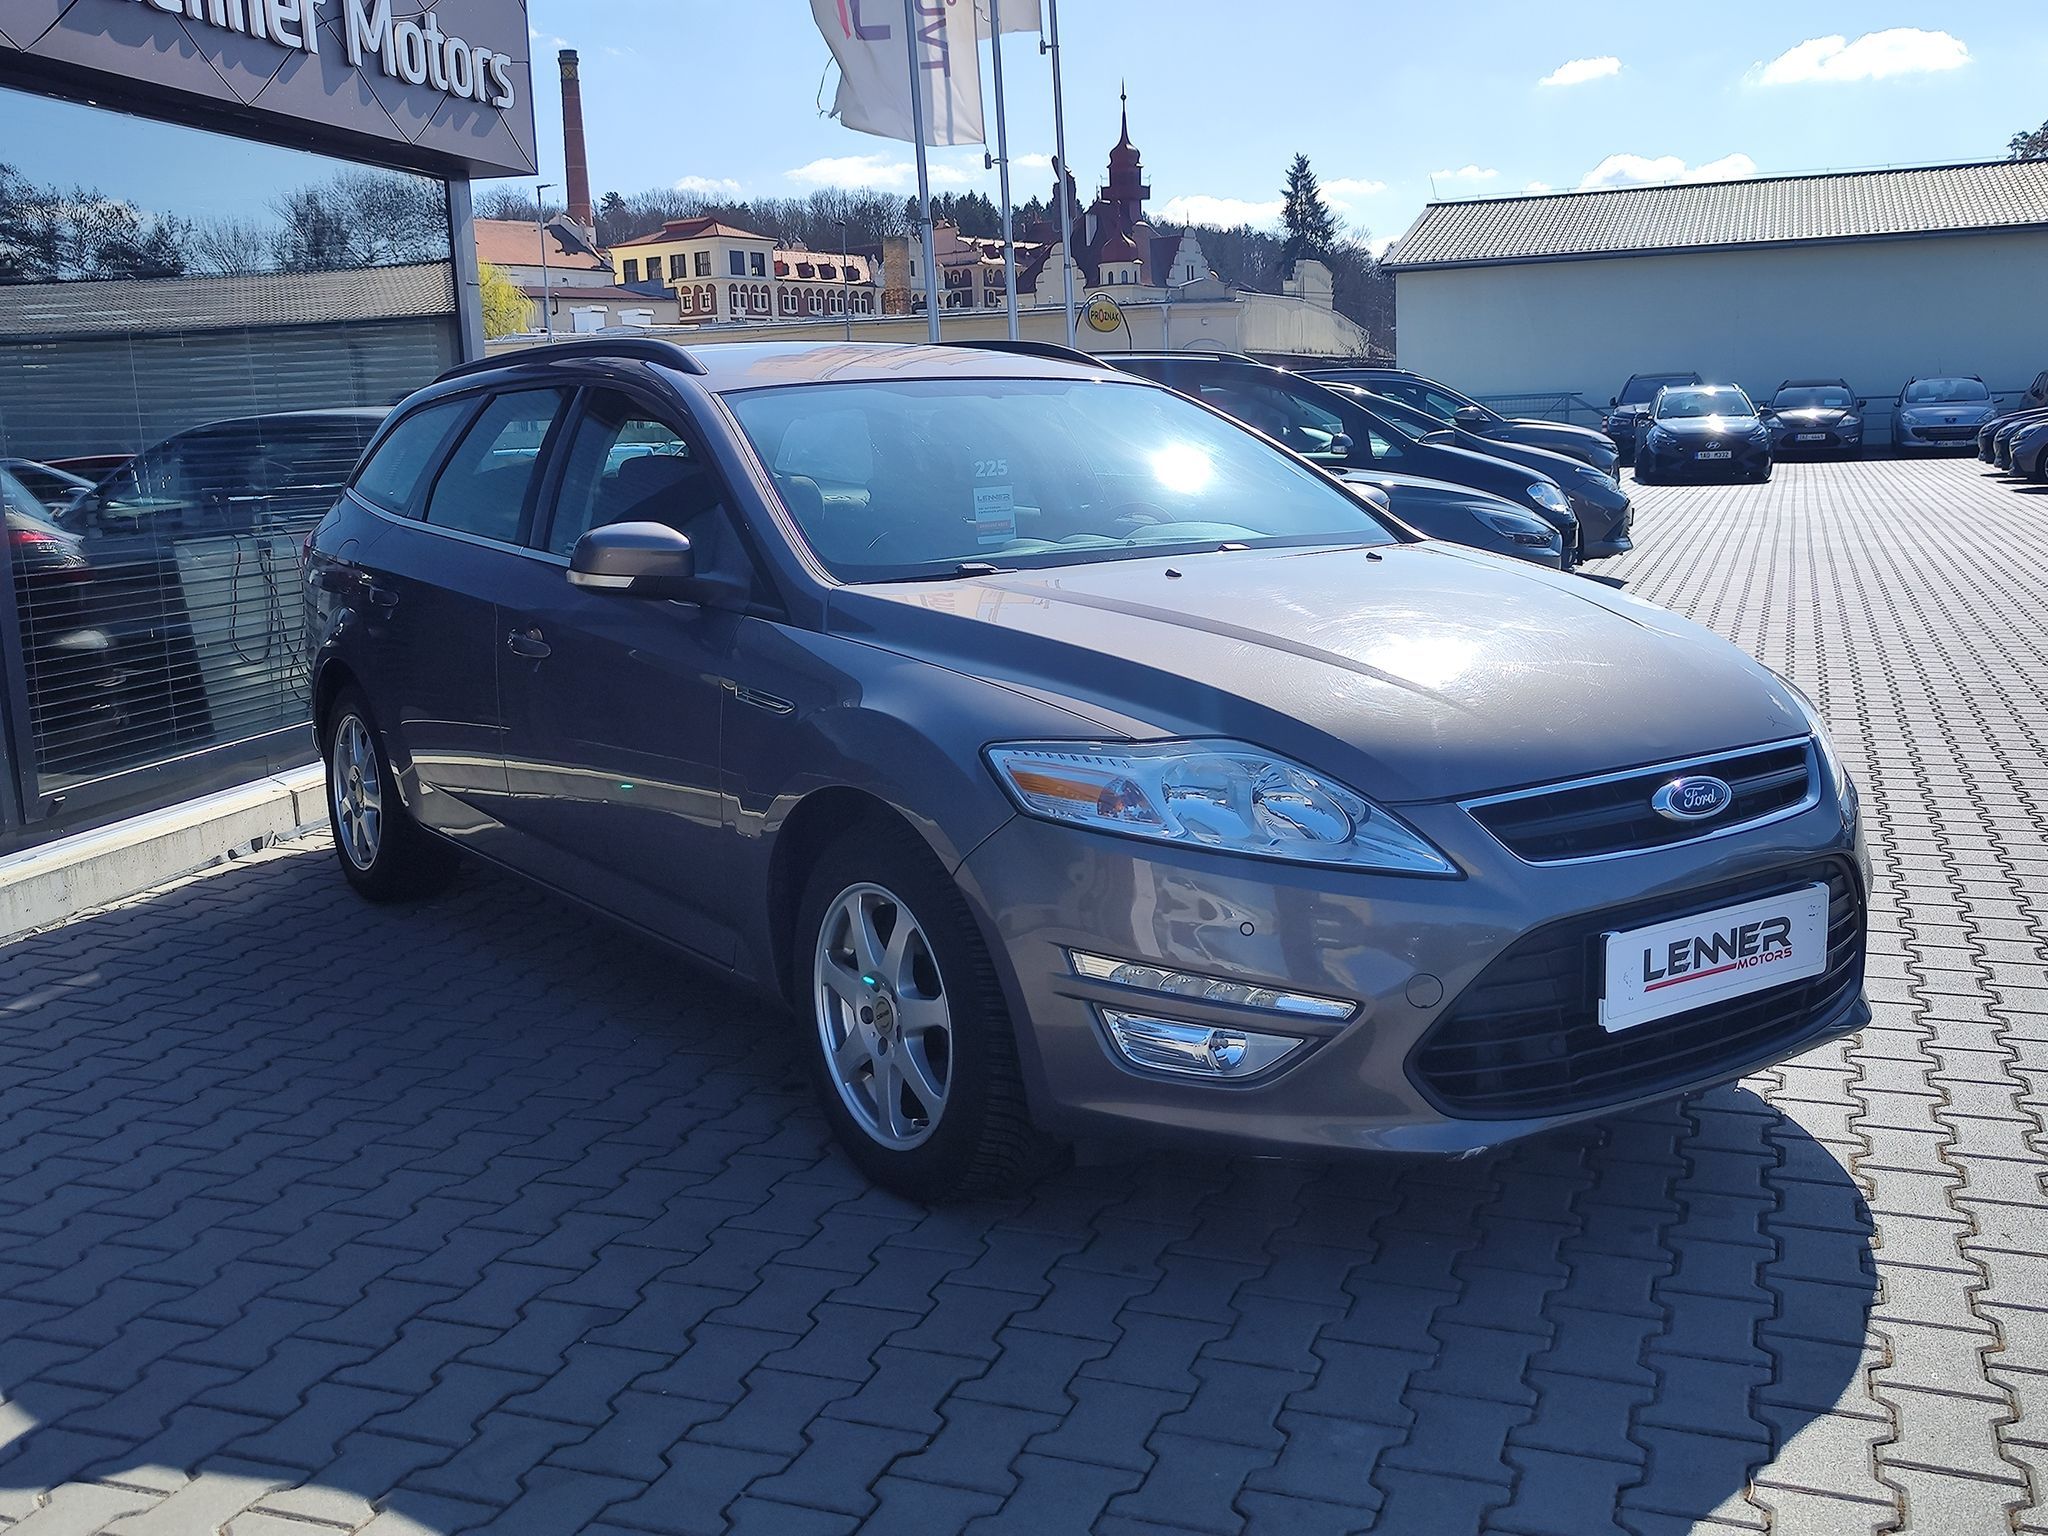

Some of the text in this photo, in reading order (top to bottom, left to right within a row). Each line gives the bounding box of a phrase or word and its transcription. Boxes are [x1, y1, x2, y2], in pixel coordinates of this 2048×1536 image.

[342, 0, 515, 109] Motors
[974, 460, 1008, 478] 225
[1683, 785, 1717, 809] Ford
[1643, 916, 1793, 983] LENNER
[1736, 947, 1794, 971] MOTORS
